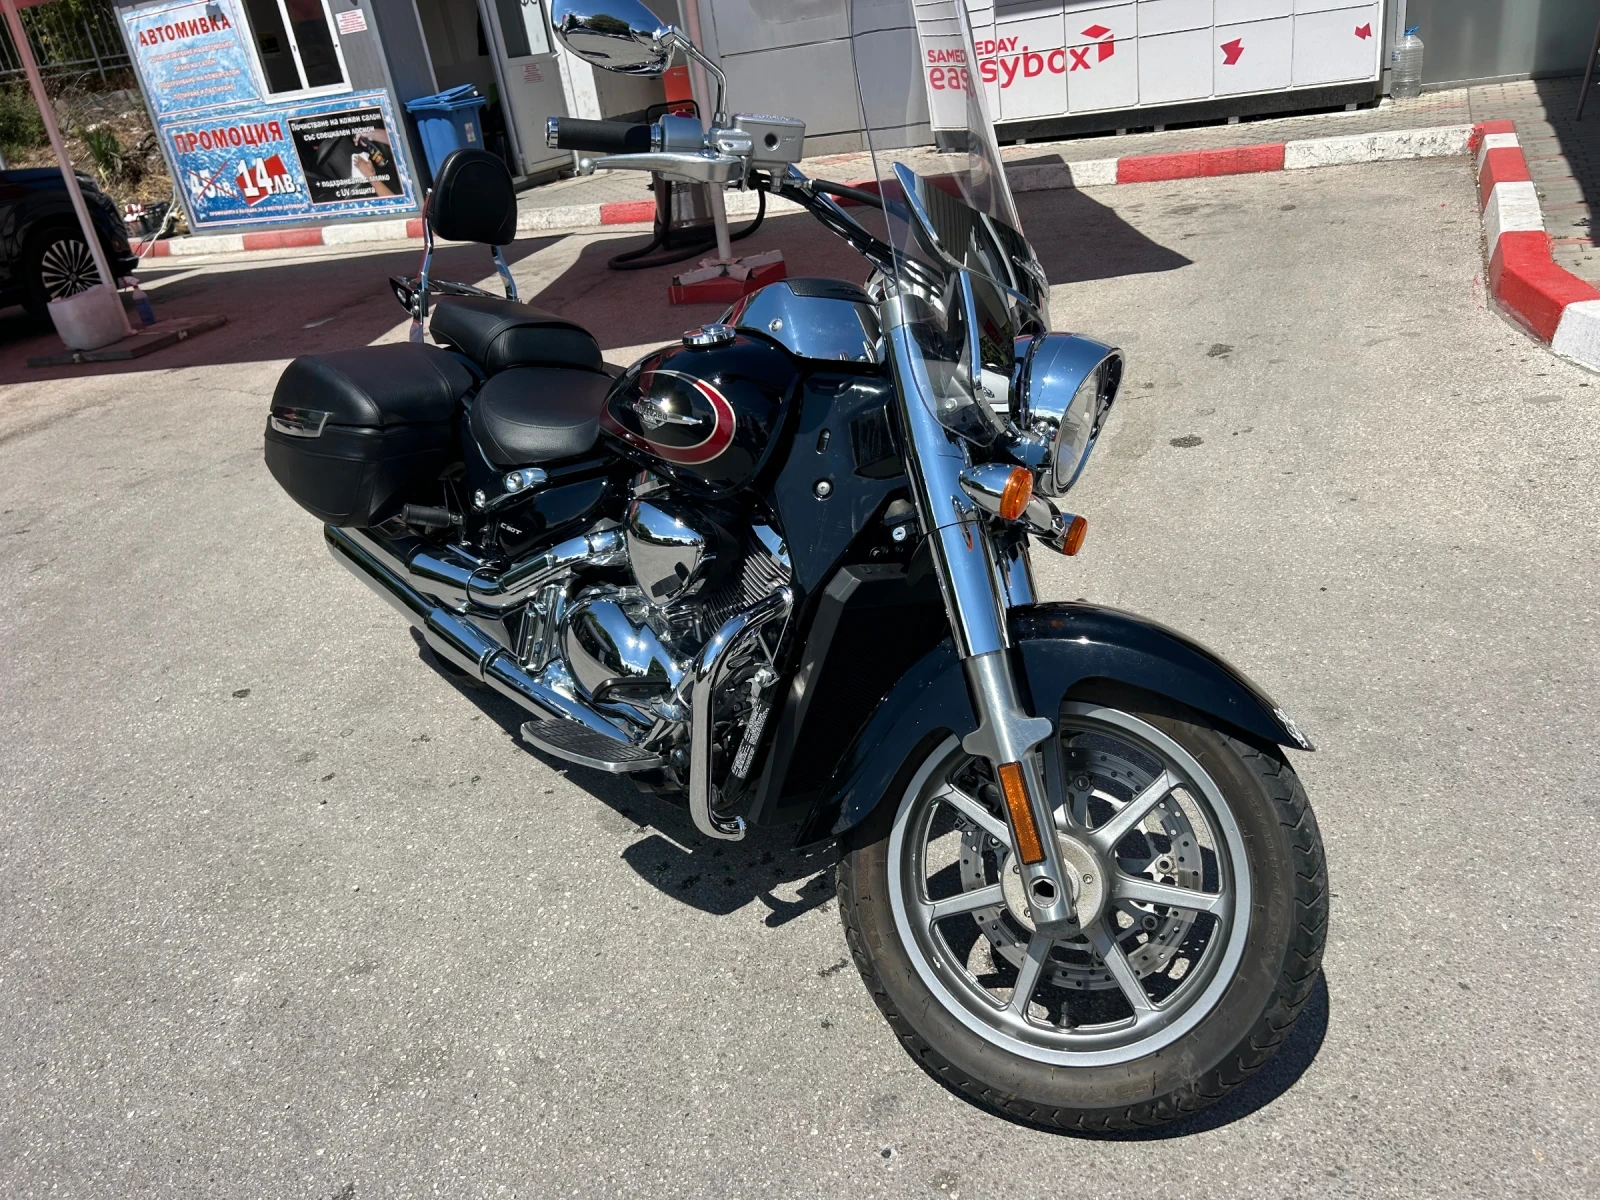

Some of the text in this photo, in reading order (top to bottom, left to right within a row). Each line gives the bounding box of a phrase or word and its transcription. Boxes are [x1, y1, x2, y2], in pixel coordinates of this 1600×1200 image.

[139, 13, 231, 47] АВТОМИВКА
[291, 113, 382, 131] Почистване на кожен салон
[174, 121, 284, 154] ПРОМОЦИЯ
[303, 133, 316, 141] със
[316, 129, 351, 140] специален
[340, 188, 350, 197] UV
[351, 187, 375, 197] защита
